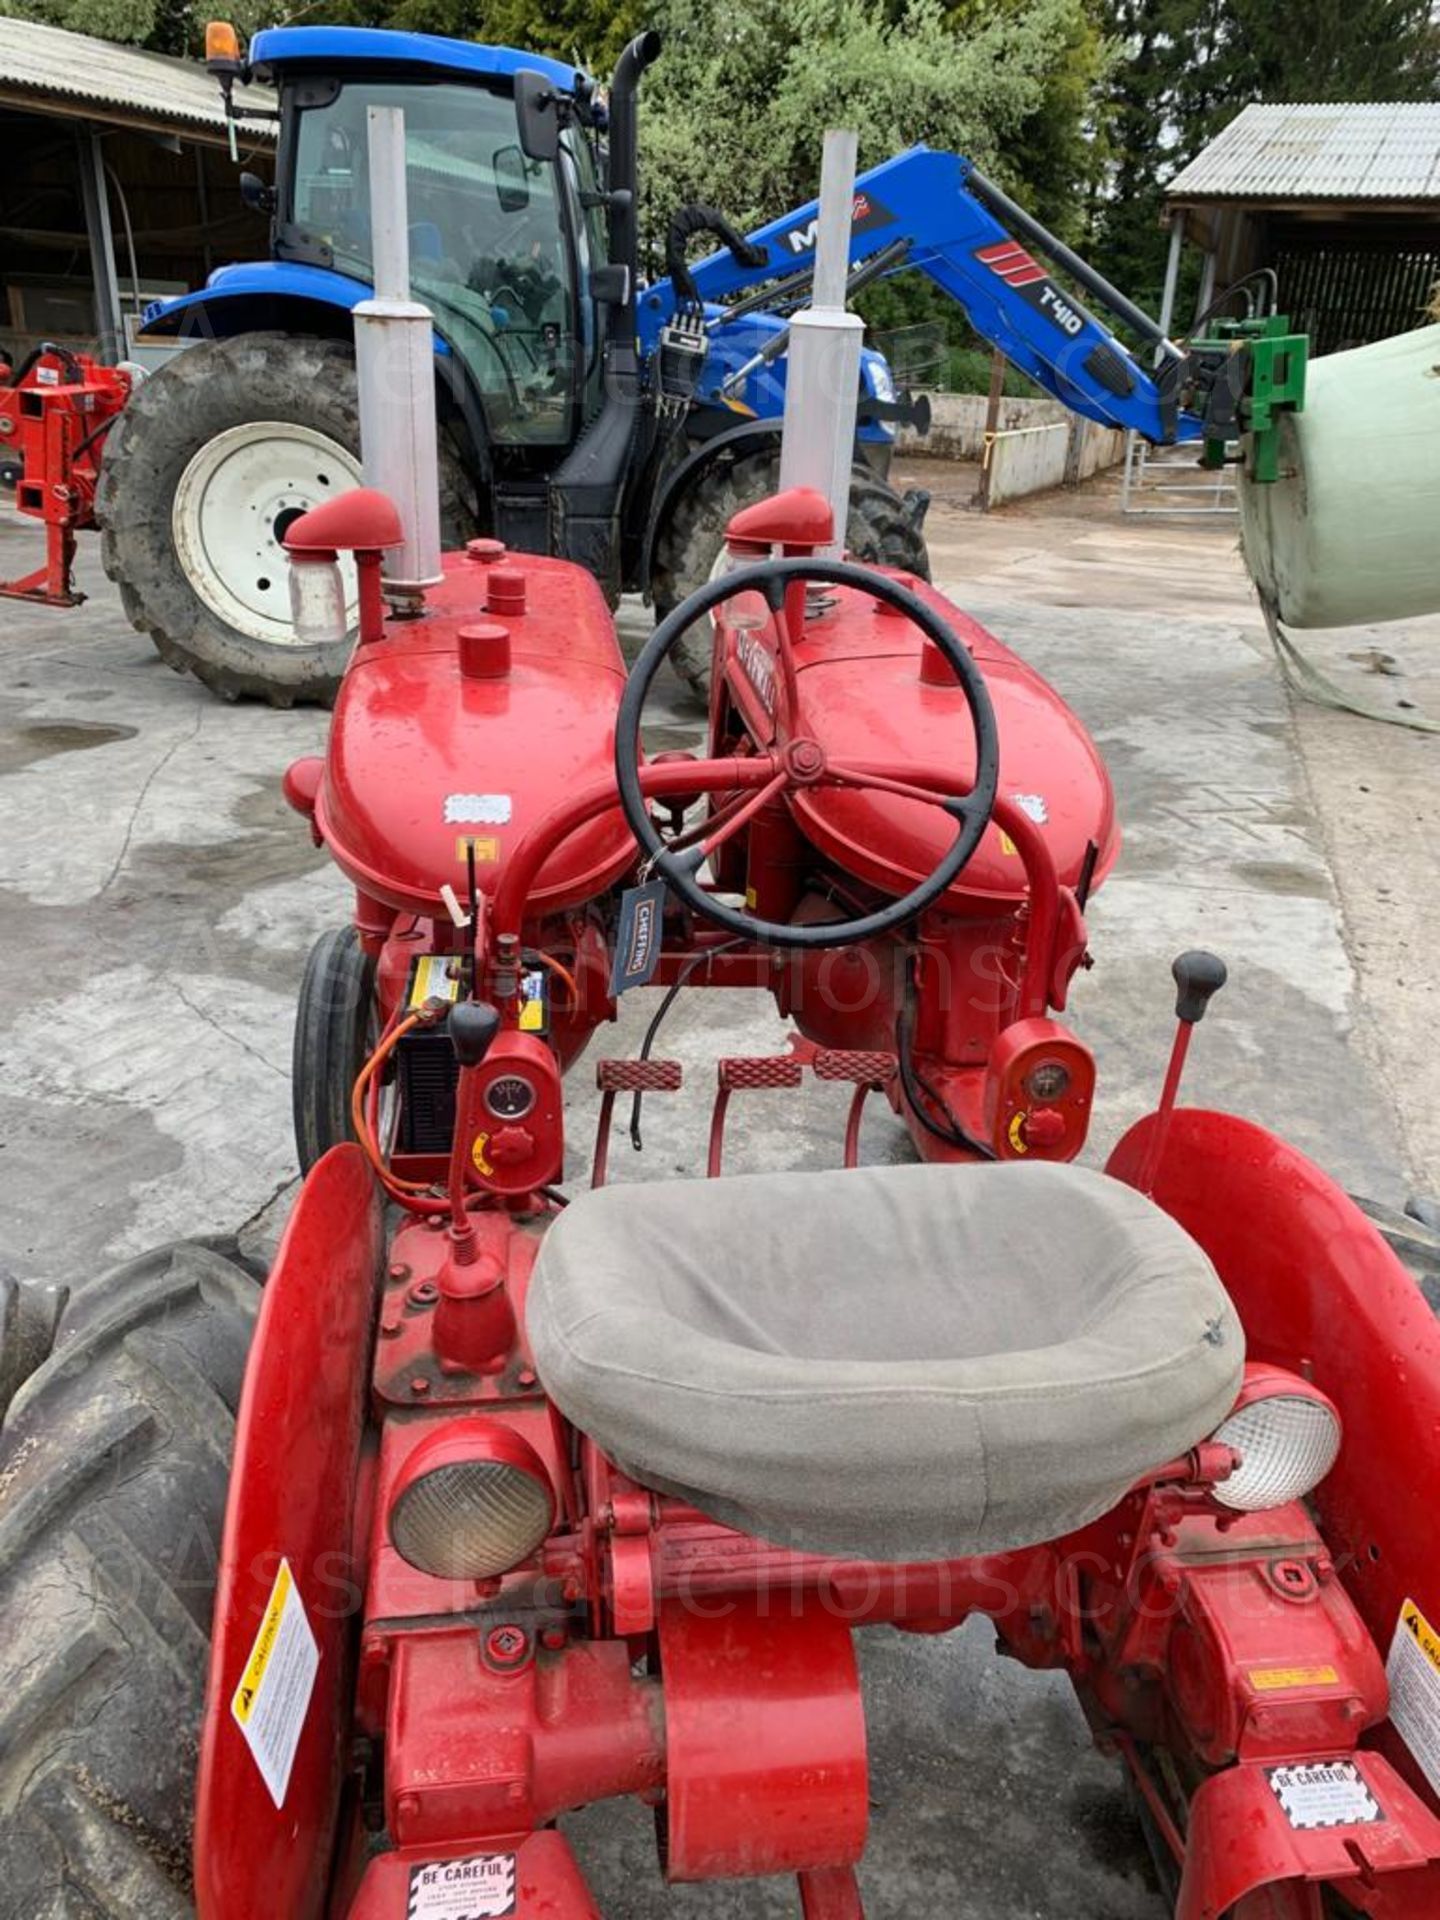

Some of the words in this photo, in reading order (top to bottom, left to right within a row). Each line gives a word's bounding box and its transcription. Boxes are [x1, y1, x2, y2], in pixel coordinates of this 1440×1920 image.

[1277, 1773, 1295, 1788] BE
[1296, 1769, 1349, 1786] CAREFUL
[422, 1871, 438, 1885] BE
[444, 1863, 503, 1881] CAREFUL
